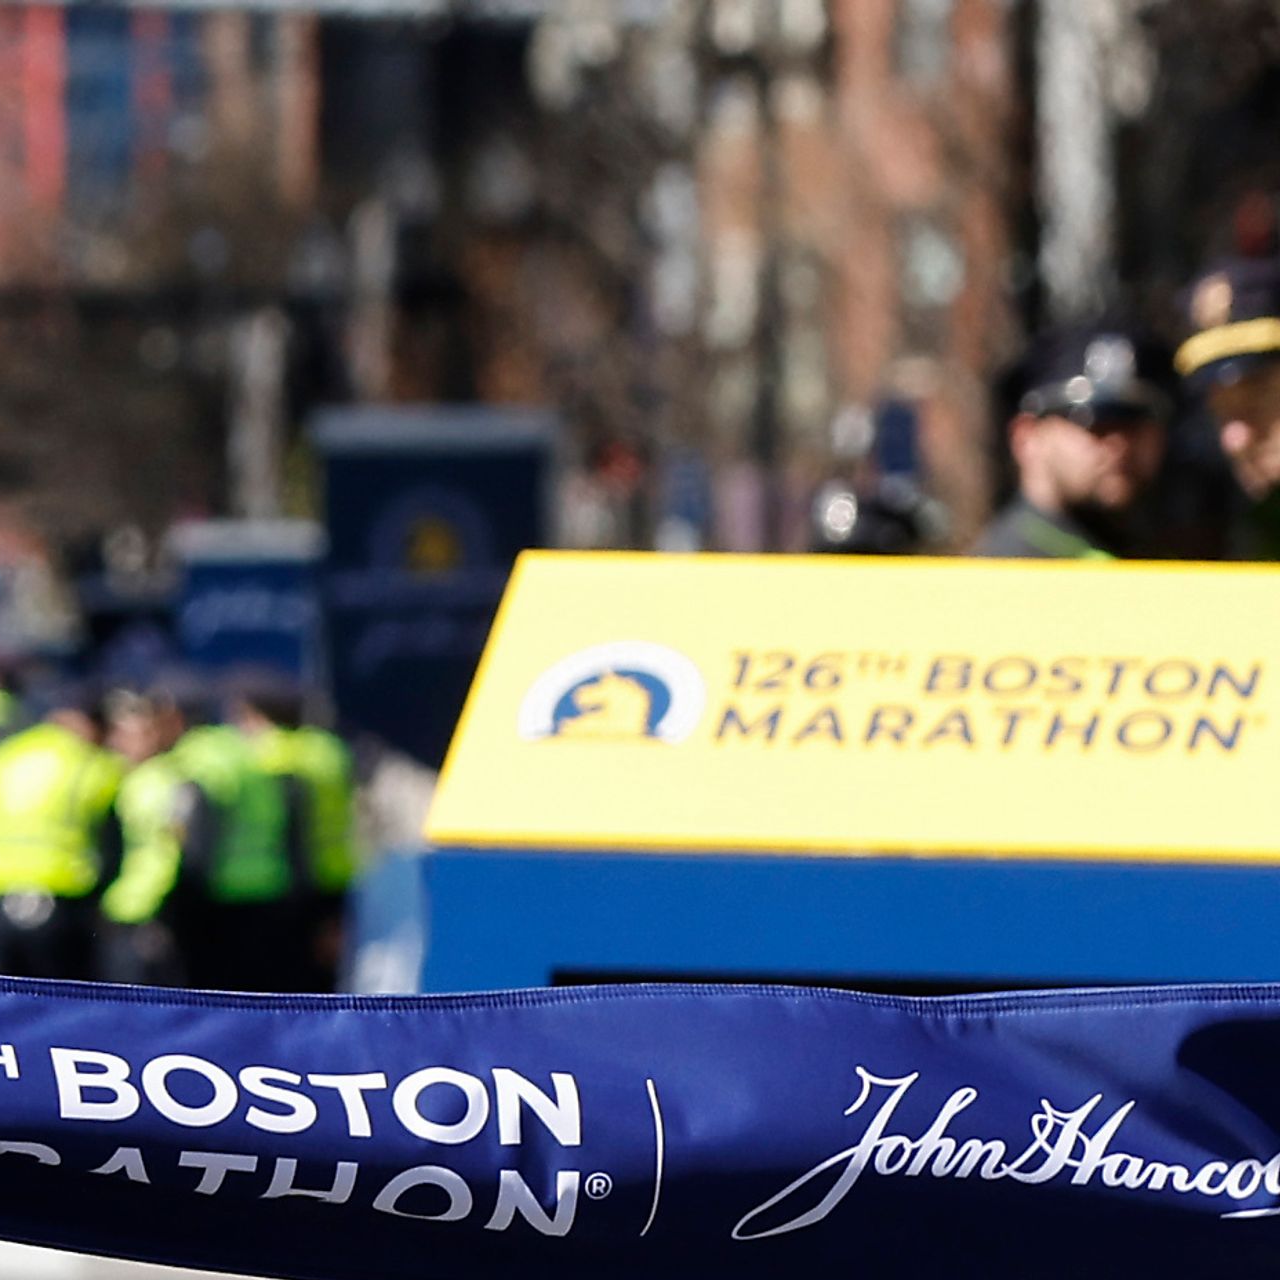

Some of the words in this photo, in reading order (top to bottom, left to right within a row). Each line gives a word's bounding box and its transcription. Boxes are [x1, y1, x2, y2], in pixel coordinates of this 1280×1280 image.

[924, 654, 1262, 701] BOSTON
[715, 703, 1248, 752] MARATHON
[50, 1047, 582, 1148] BOSTON
[731, 1066, 1008, 1240] John
